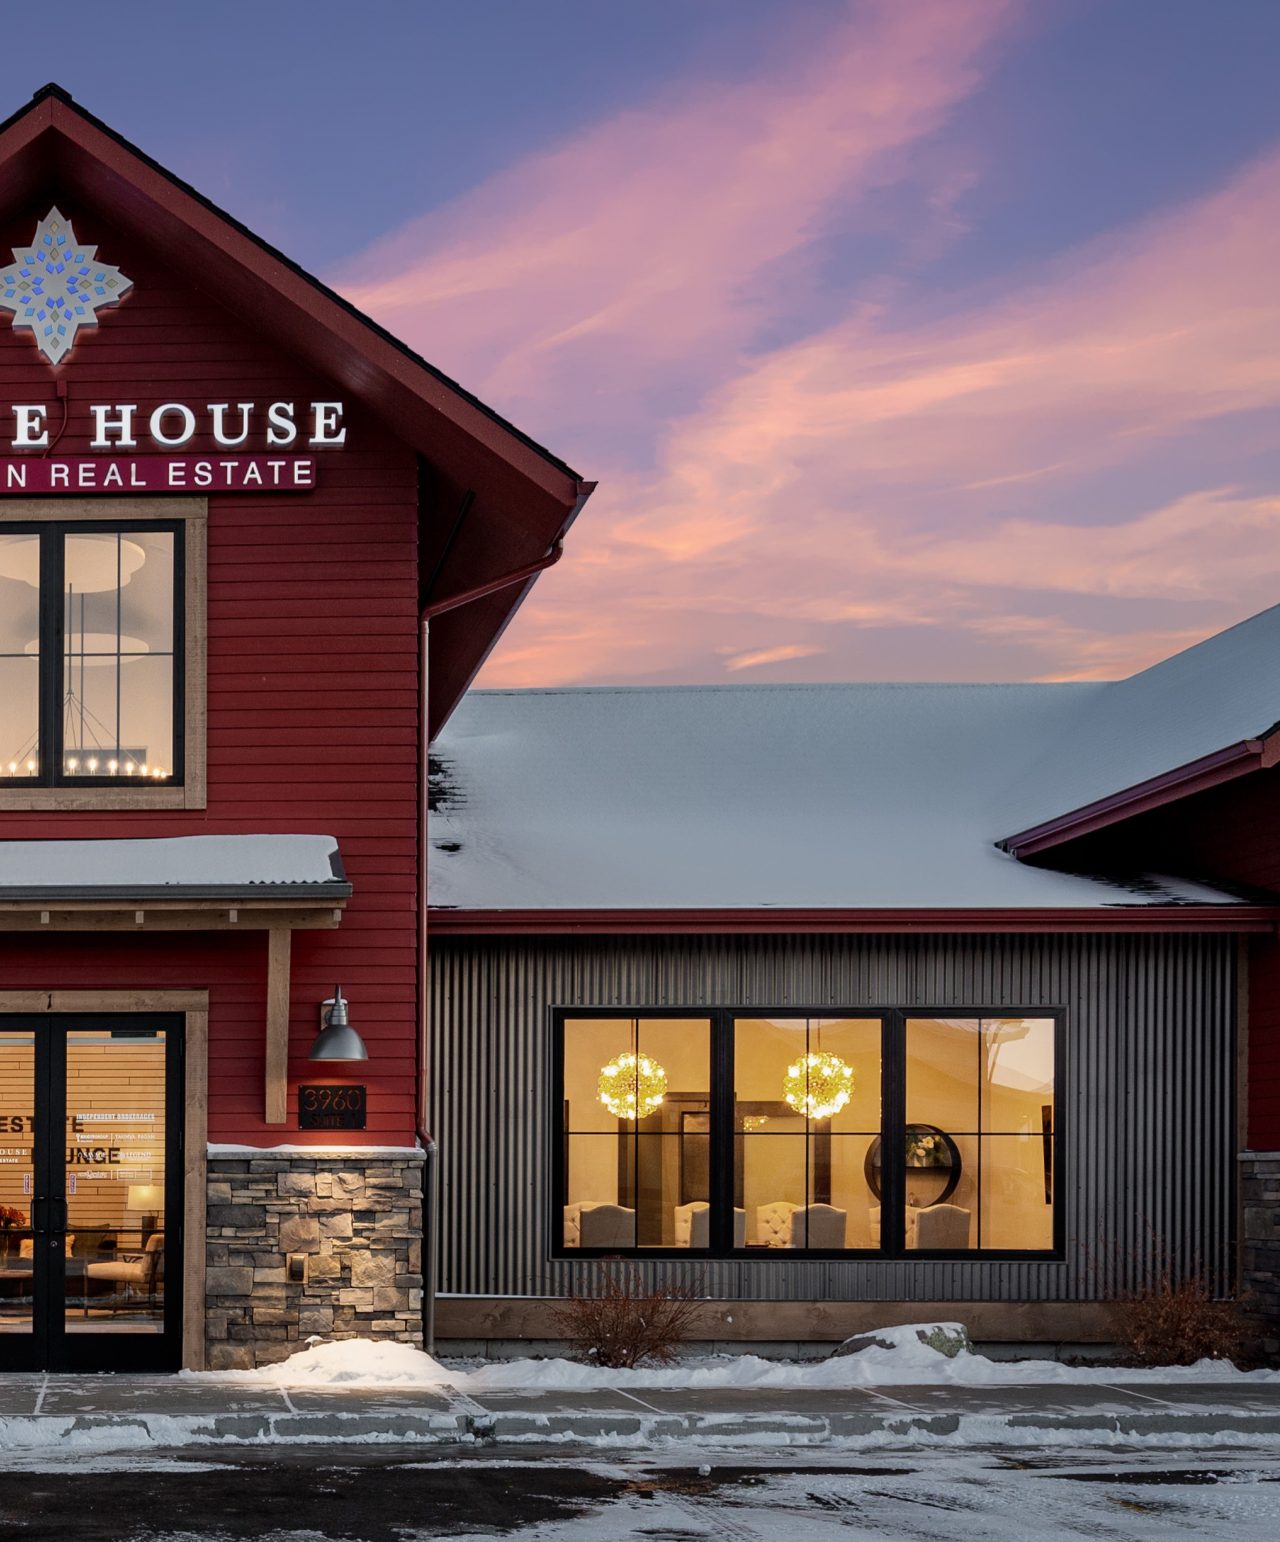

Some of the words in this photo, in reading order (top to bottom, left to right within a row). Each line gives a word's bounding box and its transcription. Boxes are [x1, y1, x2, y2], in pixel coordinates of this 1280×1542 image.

[90, 402, 347, 447] HOUSE
[51, 463, 147, 487] REAL
[168, 460, 312, 486] ESTATE
[304, 1089, 361, 1111] 3960
